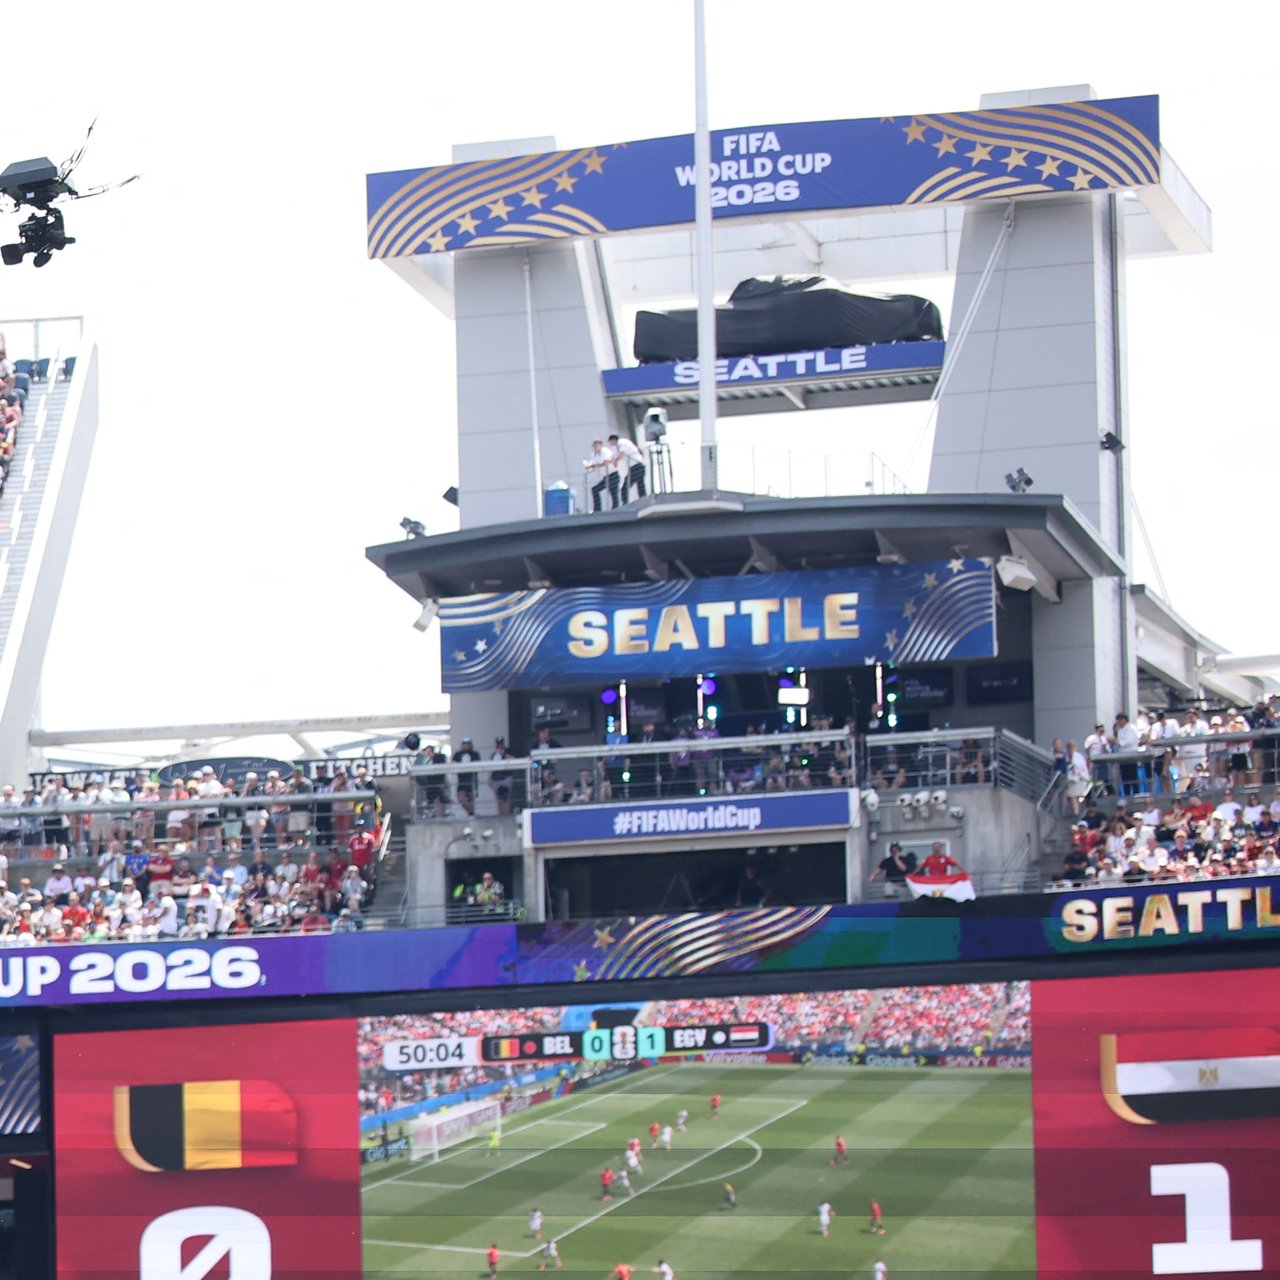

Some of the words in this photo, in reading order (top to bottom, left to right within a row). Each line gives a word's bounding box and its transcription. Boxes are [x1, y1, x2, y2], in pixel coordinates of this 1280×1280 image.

[723, 131, 781, 157] FIFA
[674, 157, 773, 188] WORLD
[777, 152, 832, 177] CUP
[709, 179, 800, 209] 2026
[673, 347, 867, 385] SEATTLE
[567, 592, 859, 658] SEATTLE
[613, 803, 762, 835] #FIFAWorldCup
[68, 946, 263, 995] 2026
[397, 1042, 464, 1065] 50:04
[542, 1035, 574, 1057] BEL
[590, 1036, 604, 1054] 0
[646, 1034, 655, 1051] 1
[1150, 1161, 1263, 1276] 1
